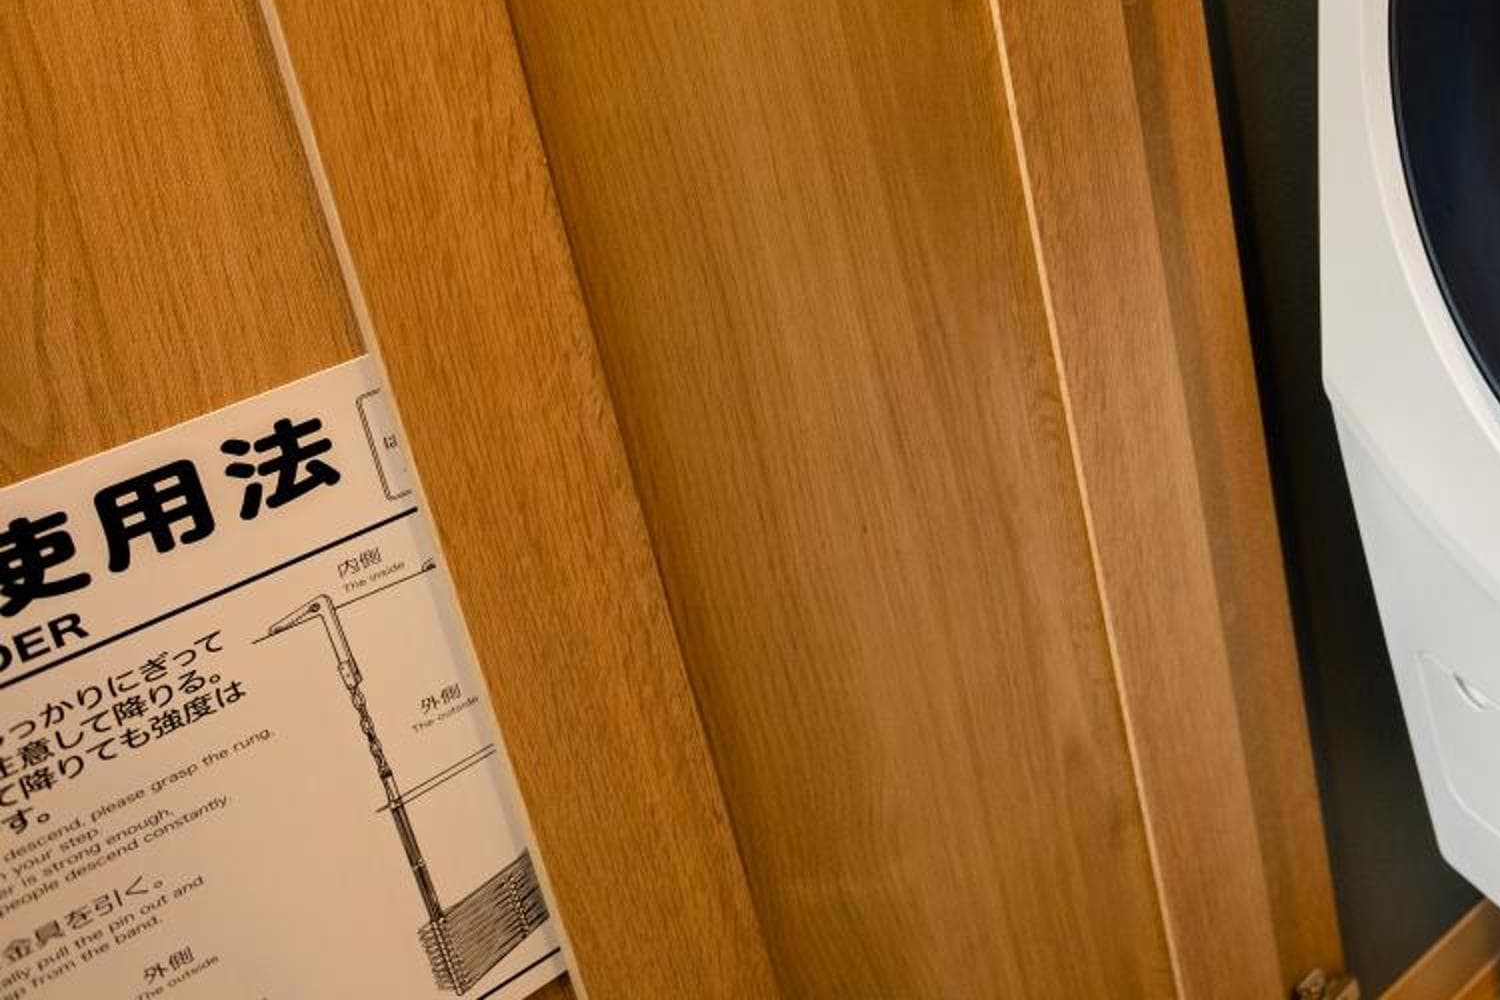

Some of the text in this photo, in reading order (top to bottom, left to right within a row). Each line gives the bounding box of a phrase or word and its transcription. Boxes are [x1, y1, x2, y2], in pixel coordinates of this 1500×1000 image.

[337, 547, 382, 579] 内側
[420, 682, 461, 715] 外側
[91, 788, 145, 823] please
[150, 763, 199, 793] grasp
[202, 748, 229, 767] the
[13, 827, 99, 877] your step
[43, 842, 102, 877] strong
[65, 837, 139, 883] descend
[75, 928, 104, 950] the
[108, 912, 136, 935] pin
[140, 894, 168, 916] out
[173, 874, 204, 899] and
[32, 959, 77, 989] from
[81, 942, 110, 963] the
[143, 945, 195, 986] 外側
